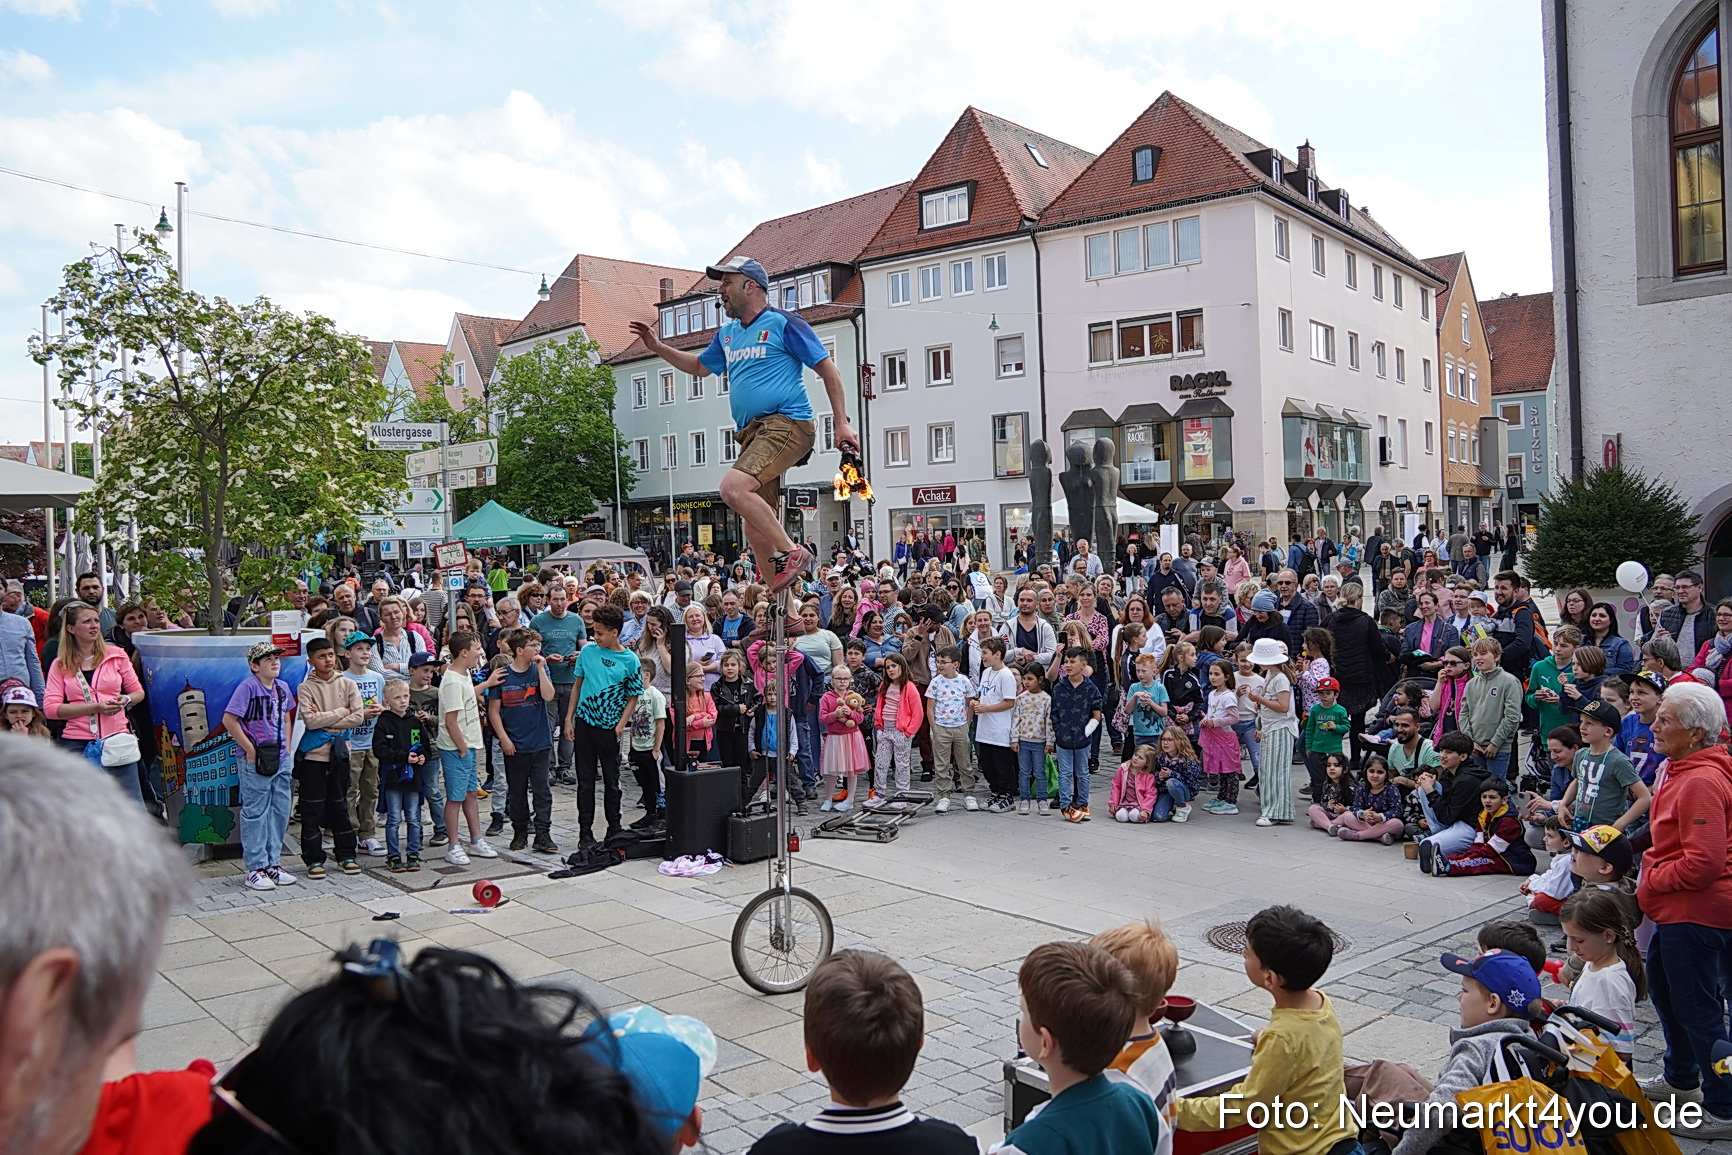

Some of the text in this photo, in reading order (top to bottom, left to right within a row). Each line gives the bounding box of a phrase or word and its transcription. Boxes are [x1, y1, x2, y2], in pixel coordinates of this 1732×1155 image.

[1169, 370, 1232, 391] RACKL
[1193, 389, 1226, 398] Rathaus
[371, 425, 433, 440] Klostergasse
[1530, 405, 1542, 473] satzke
[916, 488, 952, 504] Achatz
[672, 500, 711, 510] SONNECHKO
[372, 528, 395, 536] Pilsach
[1490, 687, 1498, 697] C
